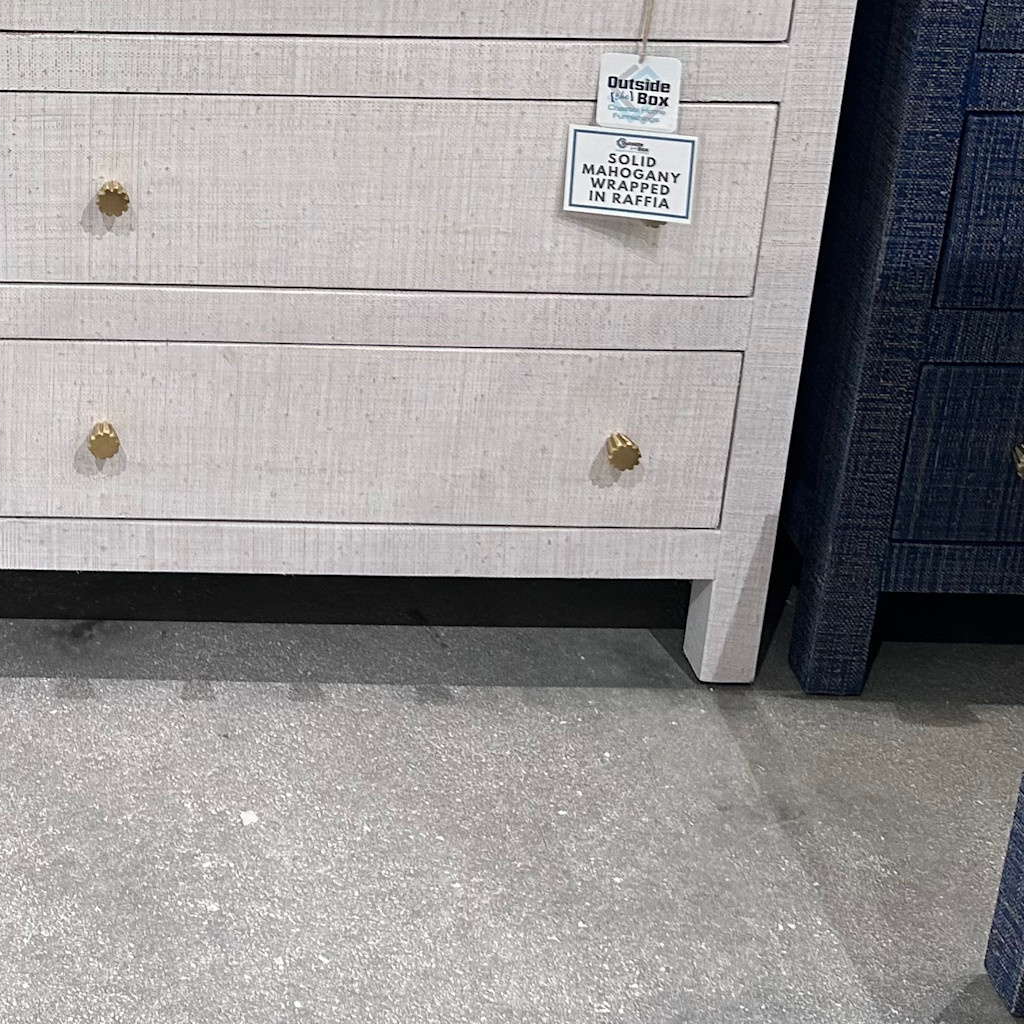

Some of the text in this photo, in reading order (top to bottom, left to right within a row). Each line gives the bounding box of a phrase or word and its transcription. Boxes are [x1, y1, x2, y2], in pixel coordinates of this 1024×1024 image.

[607, 75, 671, 94] Outside
[637, 92, 670, 107] Box
[607, 153, 657, 168] SOLID
[581, 164, 682, 184] MAHOGANY
[590, 177, 671, 196] WRAPPED
[588, 190, 670, 210] IN RAFFIA
